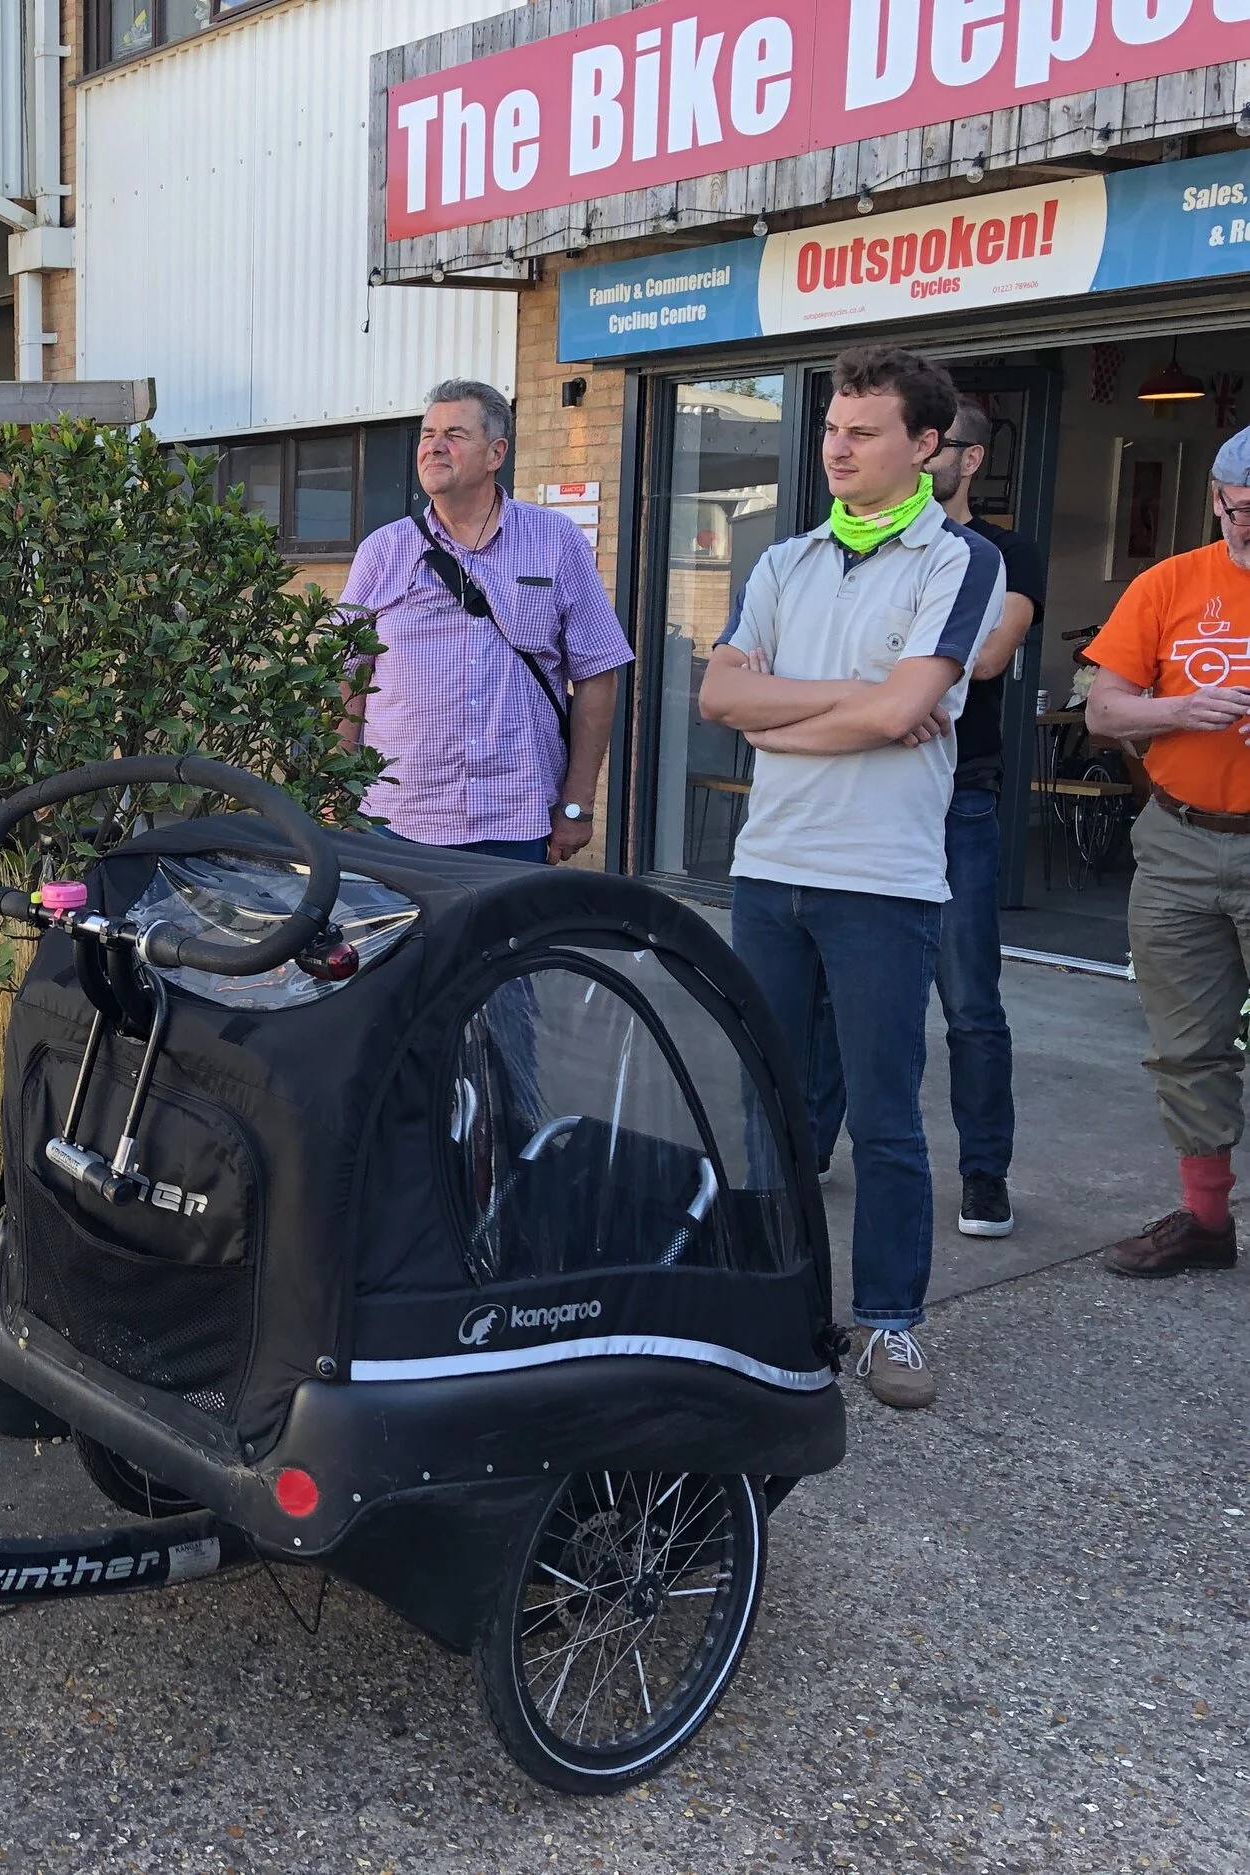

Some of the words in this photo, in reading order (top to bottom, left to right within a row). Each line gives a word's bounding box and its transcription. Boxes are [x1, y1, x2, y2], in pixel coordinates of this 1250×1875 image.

[397, 87, 541, 214] The
[569, 15, 794, 177] Bike
[845, 0, 1250, 111] Dep
[1182, 183, 1248, 212] Sales,
[796, 199, 1059, 294] Outspoken!
[1209, 225, 1225, 247] &
[589, 283, 631, 307] Family
[633, 283, 643, 300] &
[645, 265, 731, 298] Commercial
[910, 276, 961, 299] Cycles
[608, 310, 658, 334] Cycling
[660, 304, 707, 326] Centre
[511, 1300, 602, 1332] kangaroo
